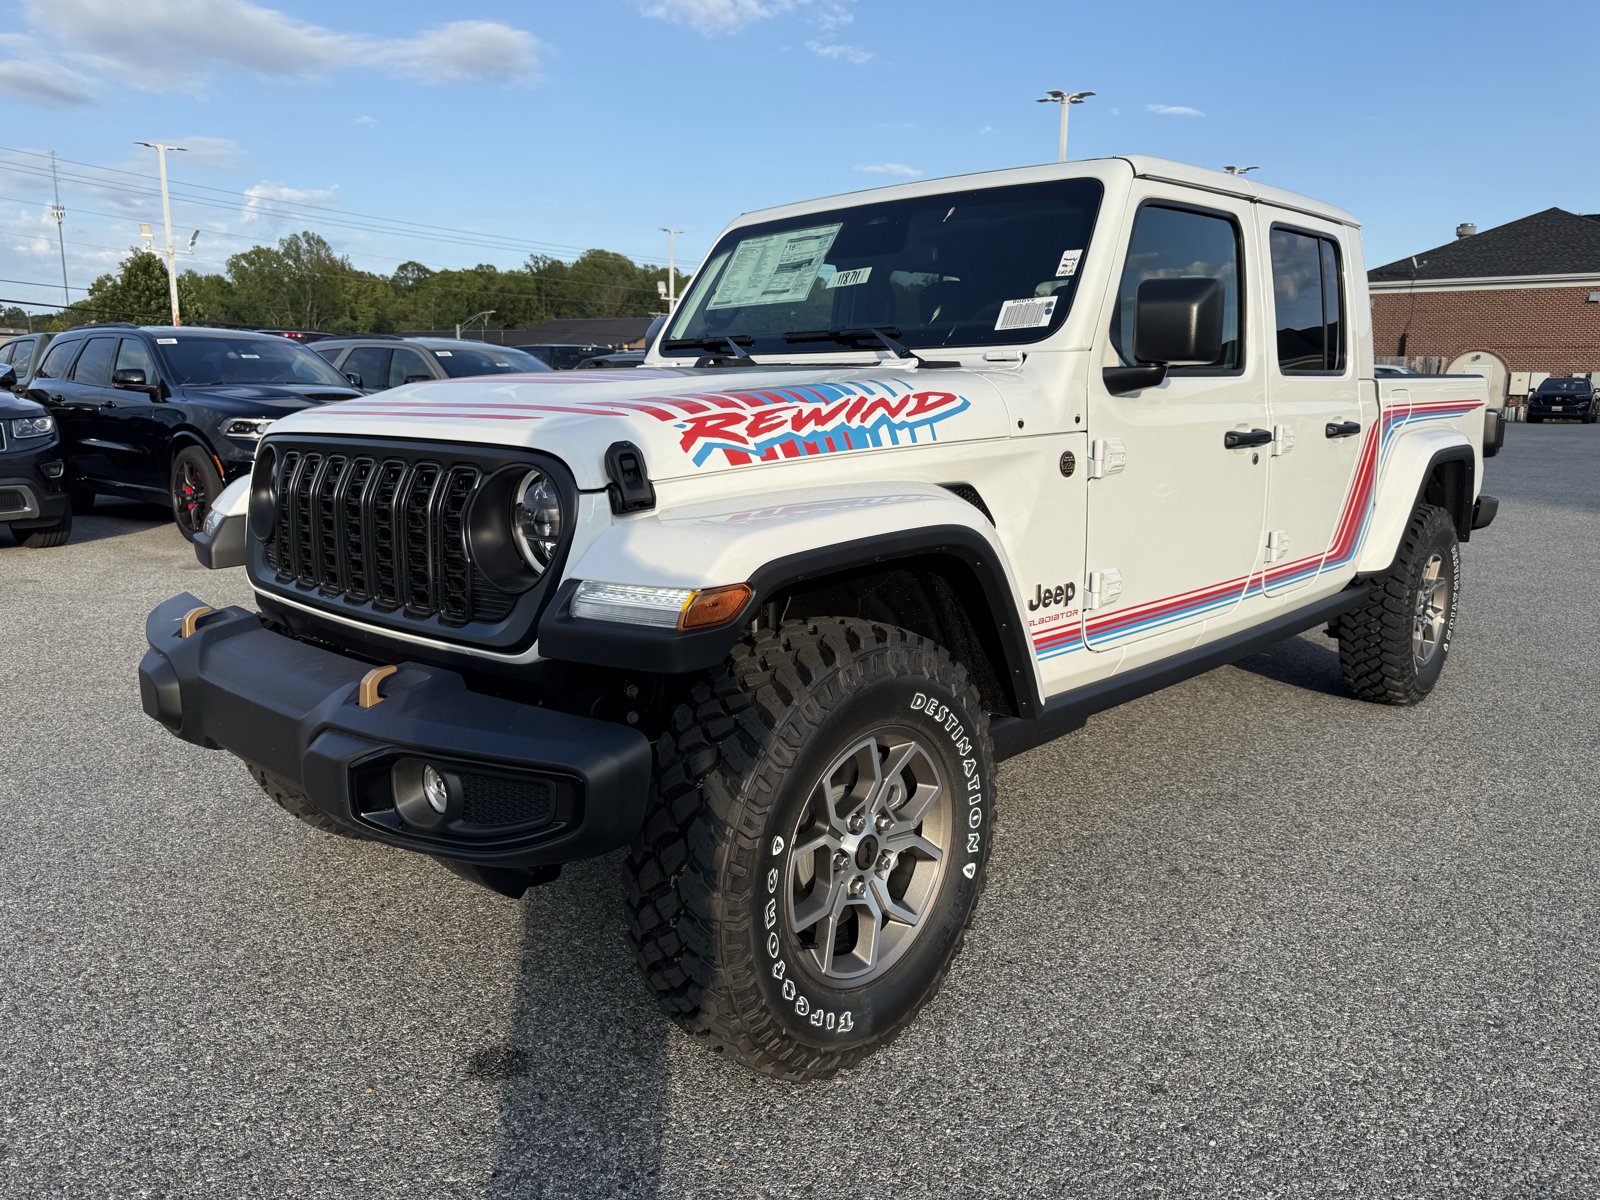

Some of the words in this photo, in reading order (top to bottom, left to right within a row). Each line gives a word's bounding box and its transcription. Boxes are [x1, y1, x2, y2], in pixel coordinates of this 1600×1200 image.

[679, 391, 958, 454] REWIND
[1027, 581, 1076, 612] Jeep
[910, 692, 982, 854] DESTINATION
